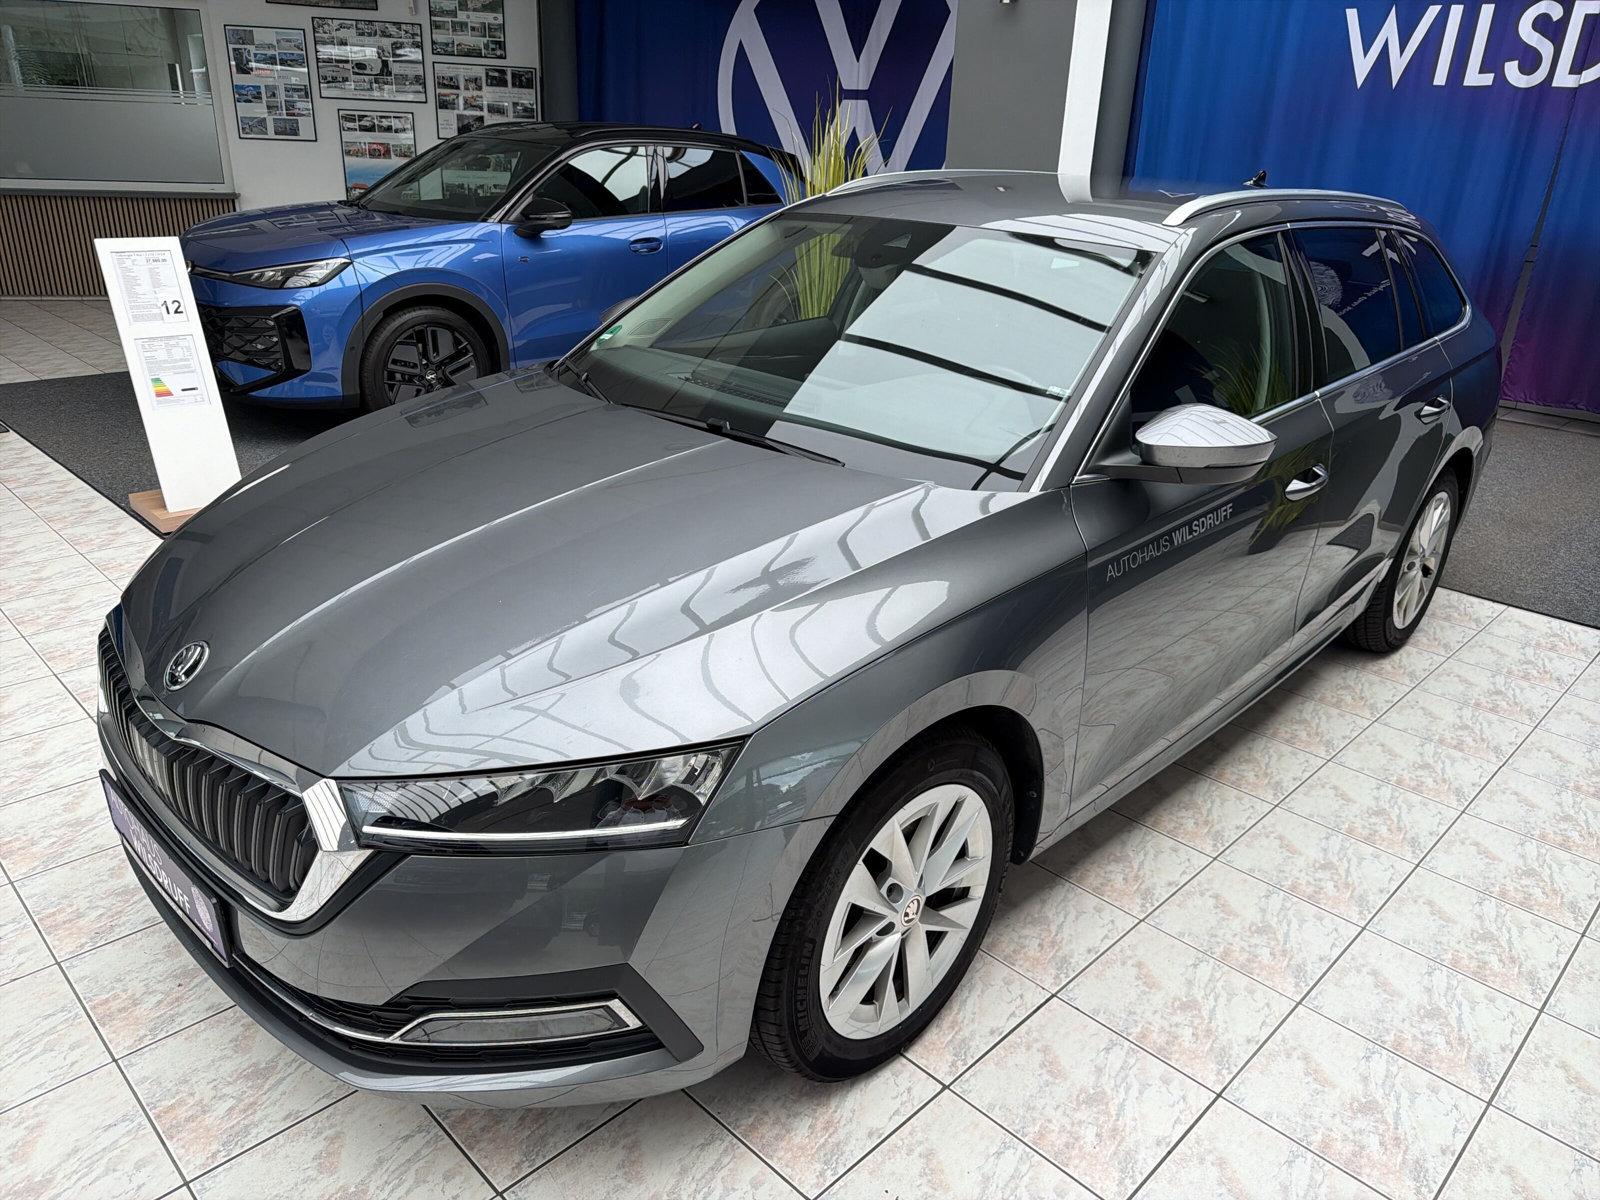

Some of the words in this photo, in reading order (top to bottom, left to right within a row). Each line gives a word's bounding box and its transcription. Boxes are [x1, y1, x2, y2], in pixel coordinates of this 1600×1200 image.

[161, 299, 184, 315] 12
[1106, 535, 1171, 582] AUTOHAUS
[1172, 503, 1234, 547] WILSDRUFF
[796, 942, 813, 1032] MICHELIN
